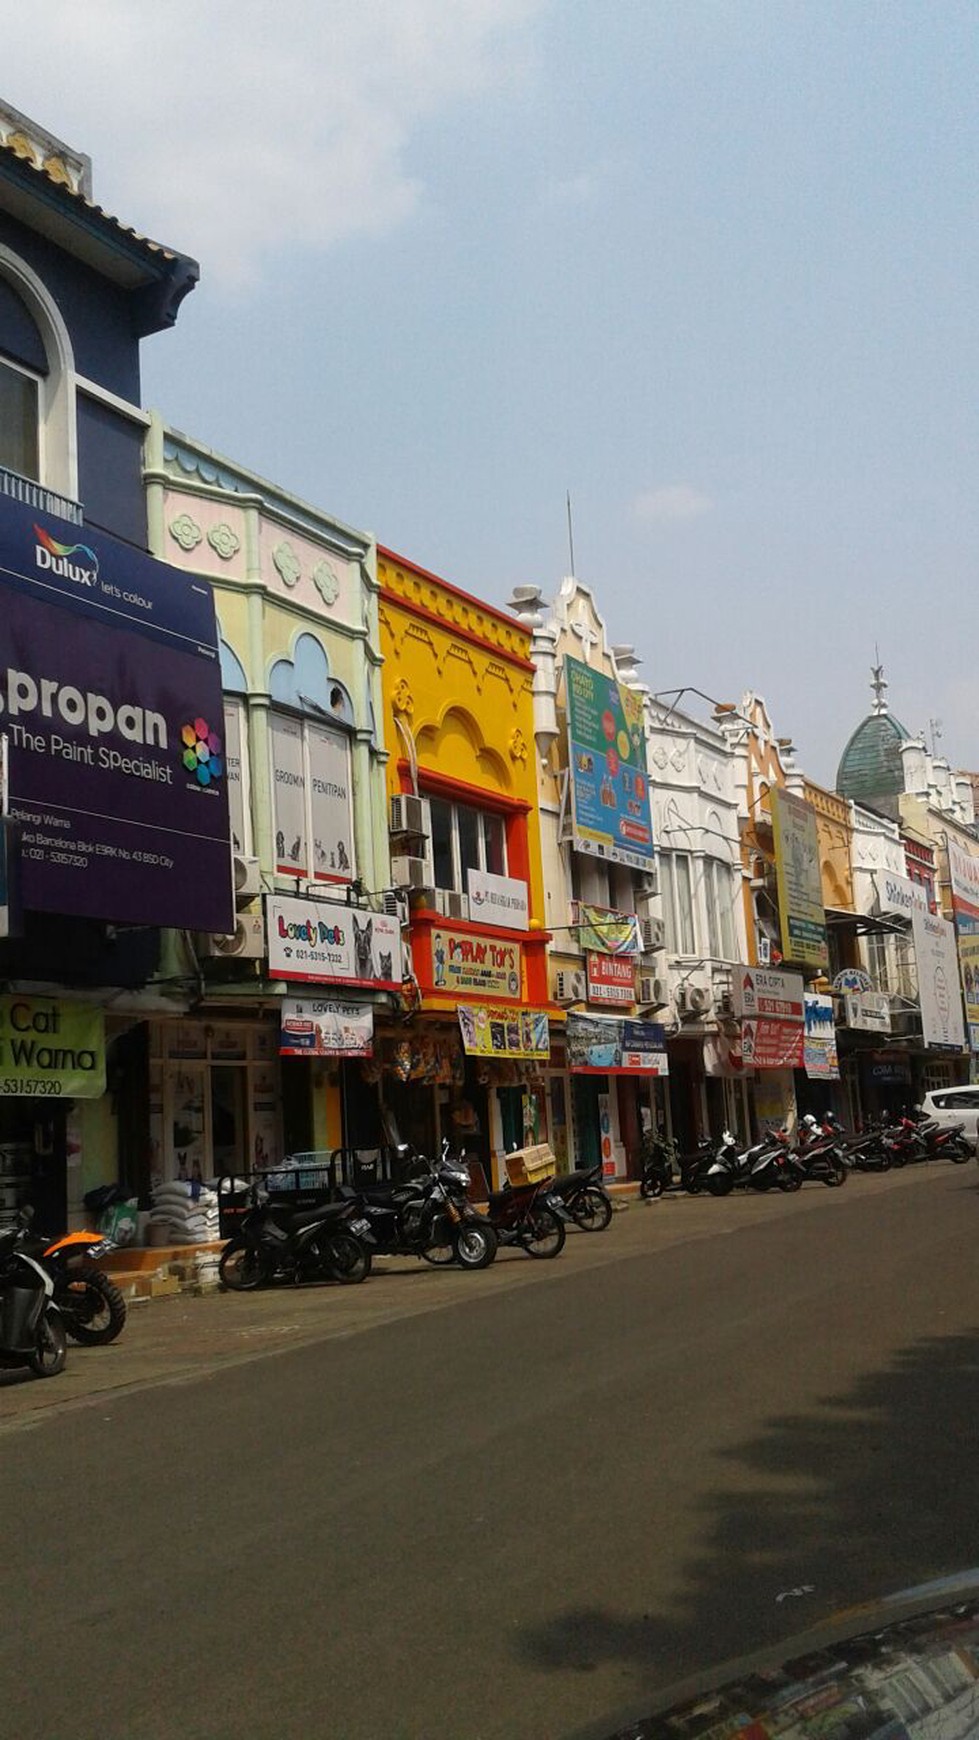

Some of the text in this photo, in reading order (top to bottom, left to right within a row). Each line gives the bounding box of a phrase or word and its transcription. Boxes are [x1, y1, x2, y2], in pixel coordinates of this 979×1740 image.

[35, 544, 93, 587] Dulux
[101, 581, 153, 609] let's colour
[7, 668, 168, 749] propan
[9, 723, 46, 753] The
[51, 735, 95, 766] Paint
[36, 834, 76, 852] Barcelona
[277, 914, 345, 948] Lovely Pets
[601, 961, 632, 979] BINTANG
[10, 1002, 61, 1034] Cat
[312, 1003, 360, 1015] LOVELY PETS
[11, 1038, 98, 1071] Warna
